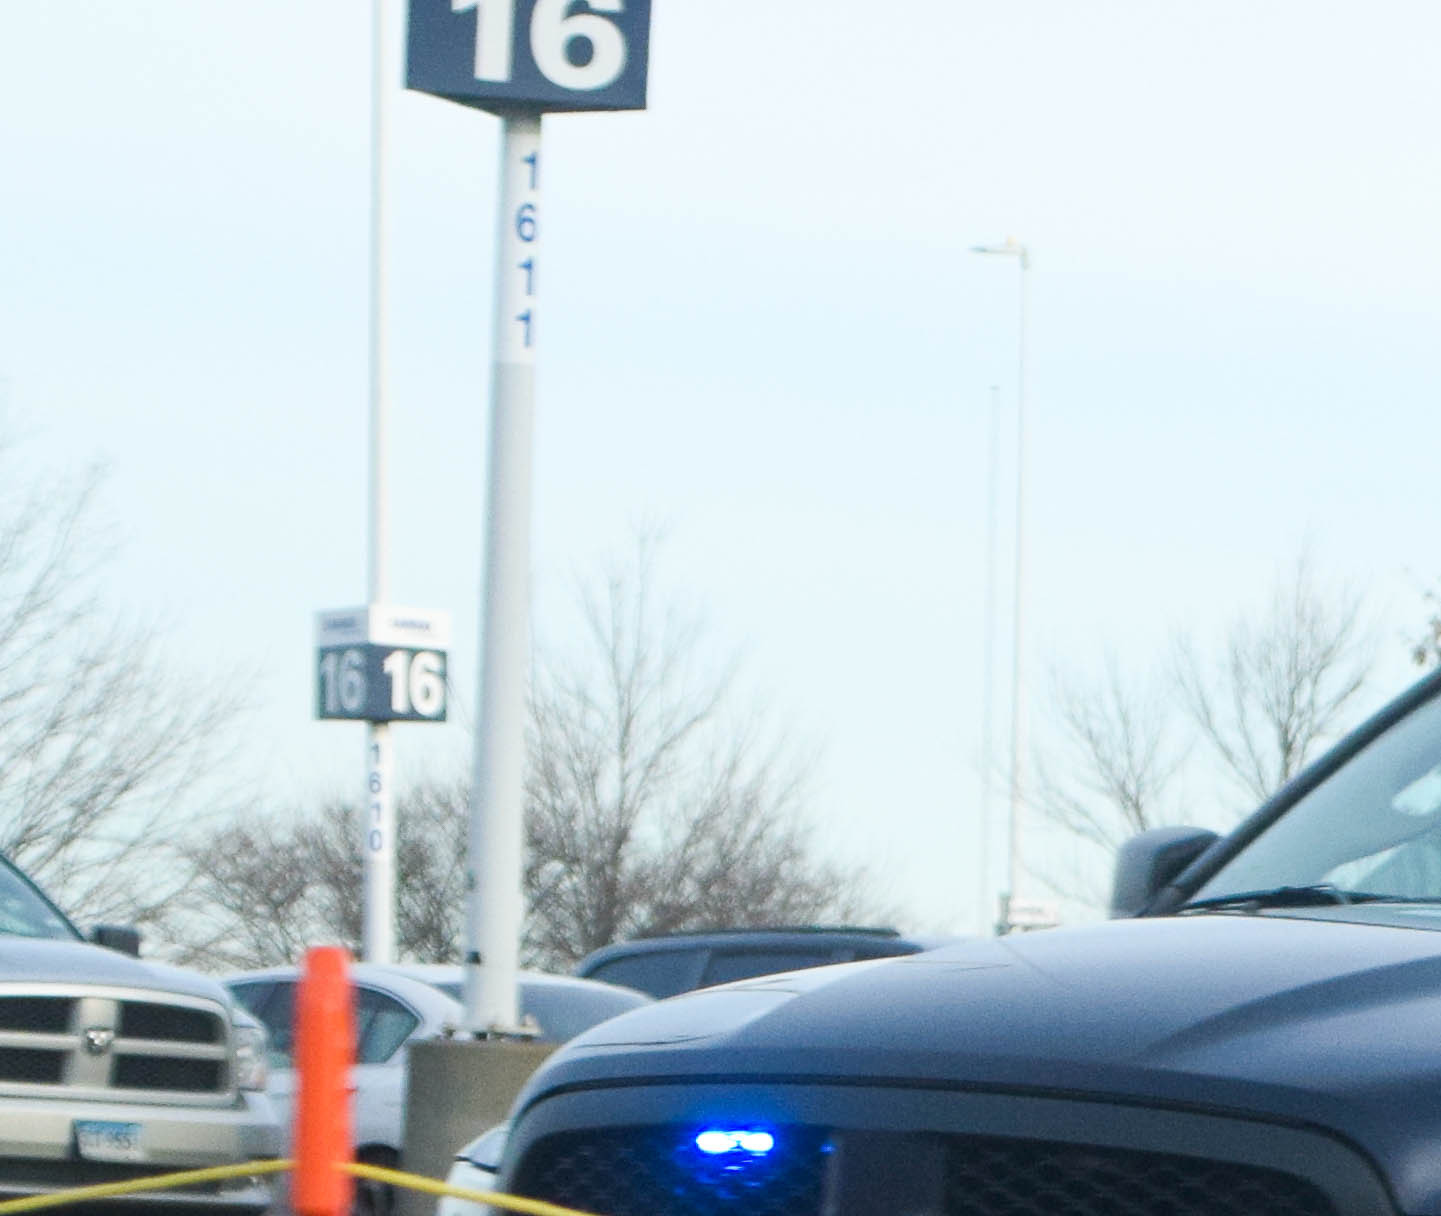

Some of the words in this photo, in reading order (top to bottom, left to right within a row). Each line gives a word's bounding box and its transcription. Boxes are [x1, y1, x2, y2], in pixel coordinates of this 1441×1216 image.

[450, 0, 626, 91] 16
[514, 151, 539, 348] 1611
[320, 650, 367, 713] 16
[383, 649, 446, 717] 16
